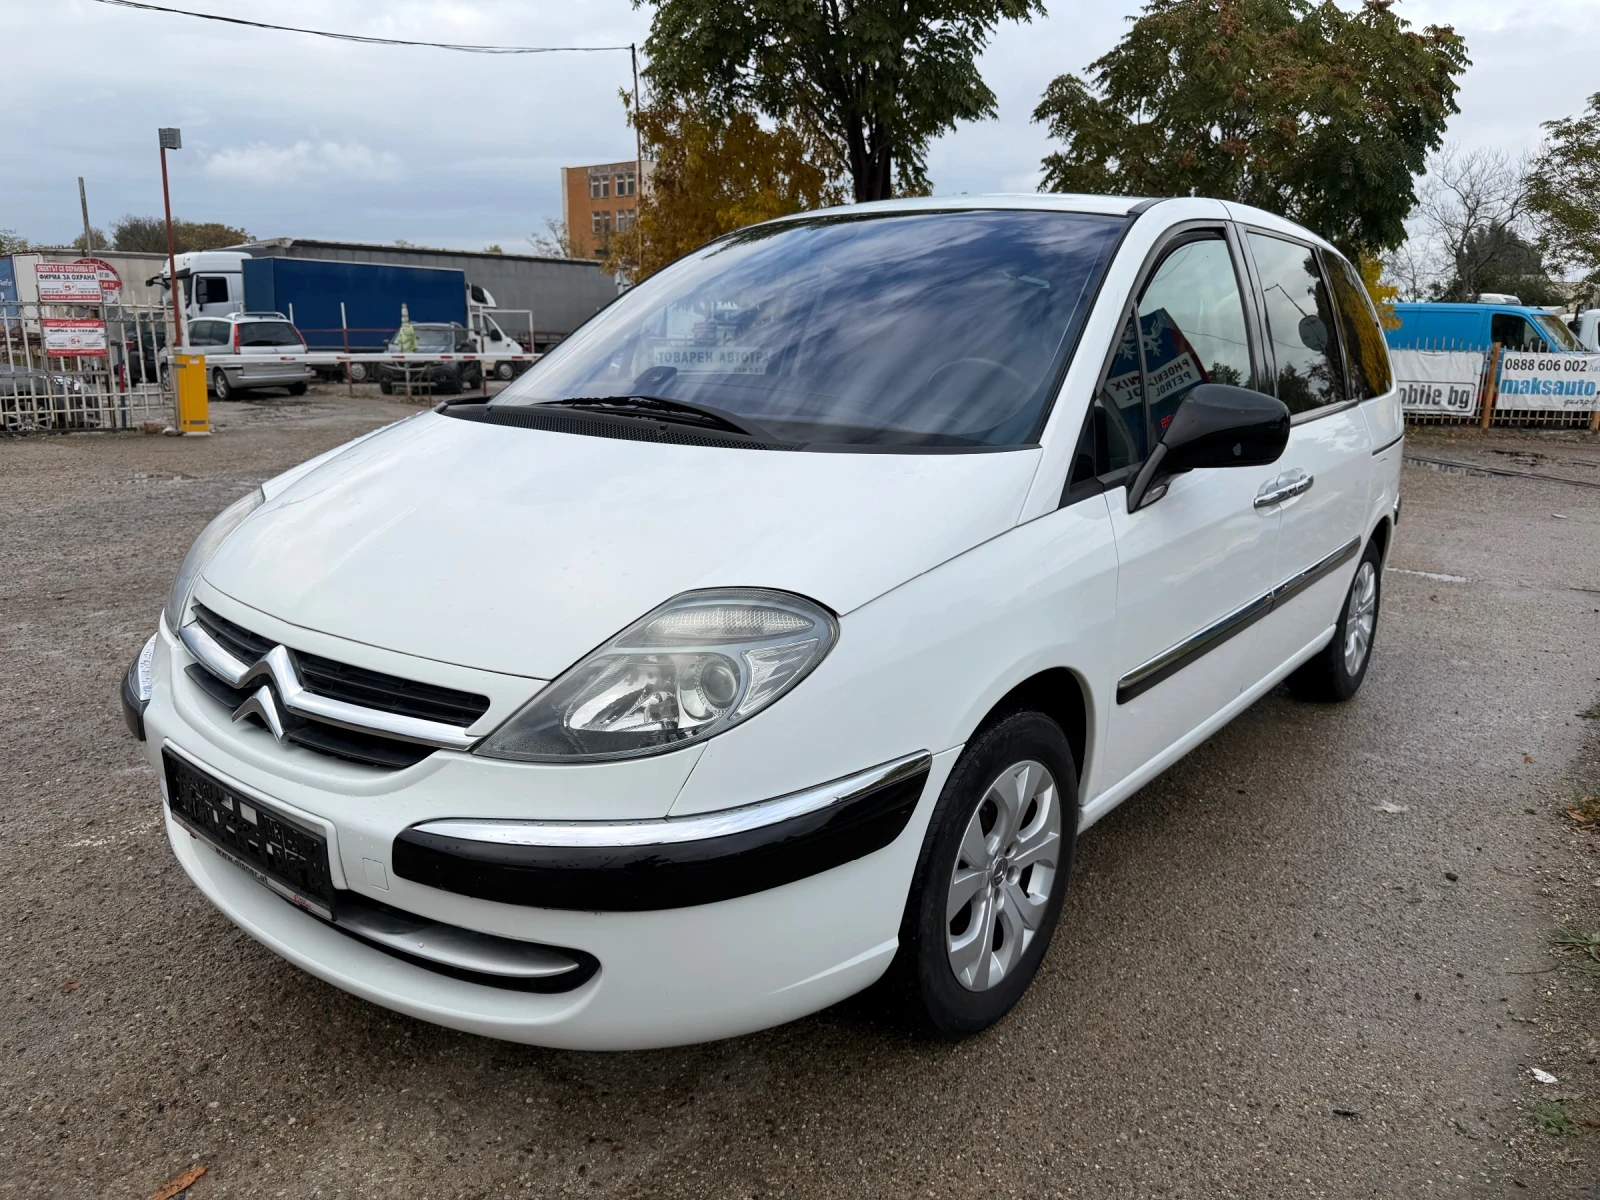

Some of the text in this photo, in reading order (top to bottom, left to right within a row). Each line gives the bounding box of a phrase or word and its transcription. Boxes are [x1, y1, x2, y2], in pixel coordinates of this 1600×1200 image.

[658, 351, 713, 364] ТОВАРЕН
[1505, 358, 1588, 372] 0888 606 002
[1448, 385, 1470, 409] bg
